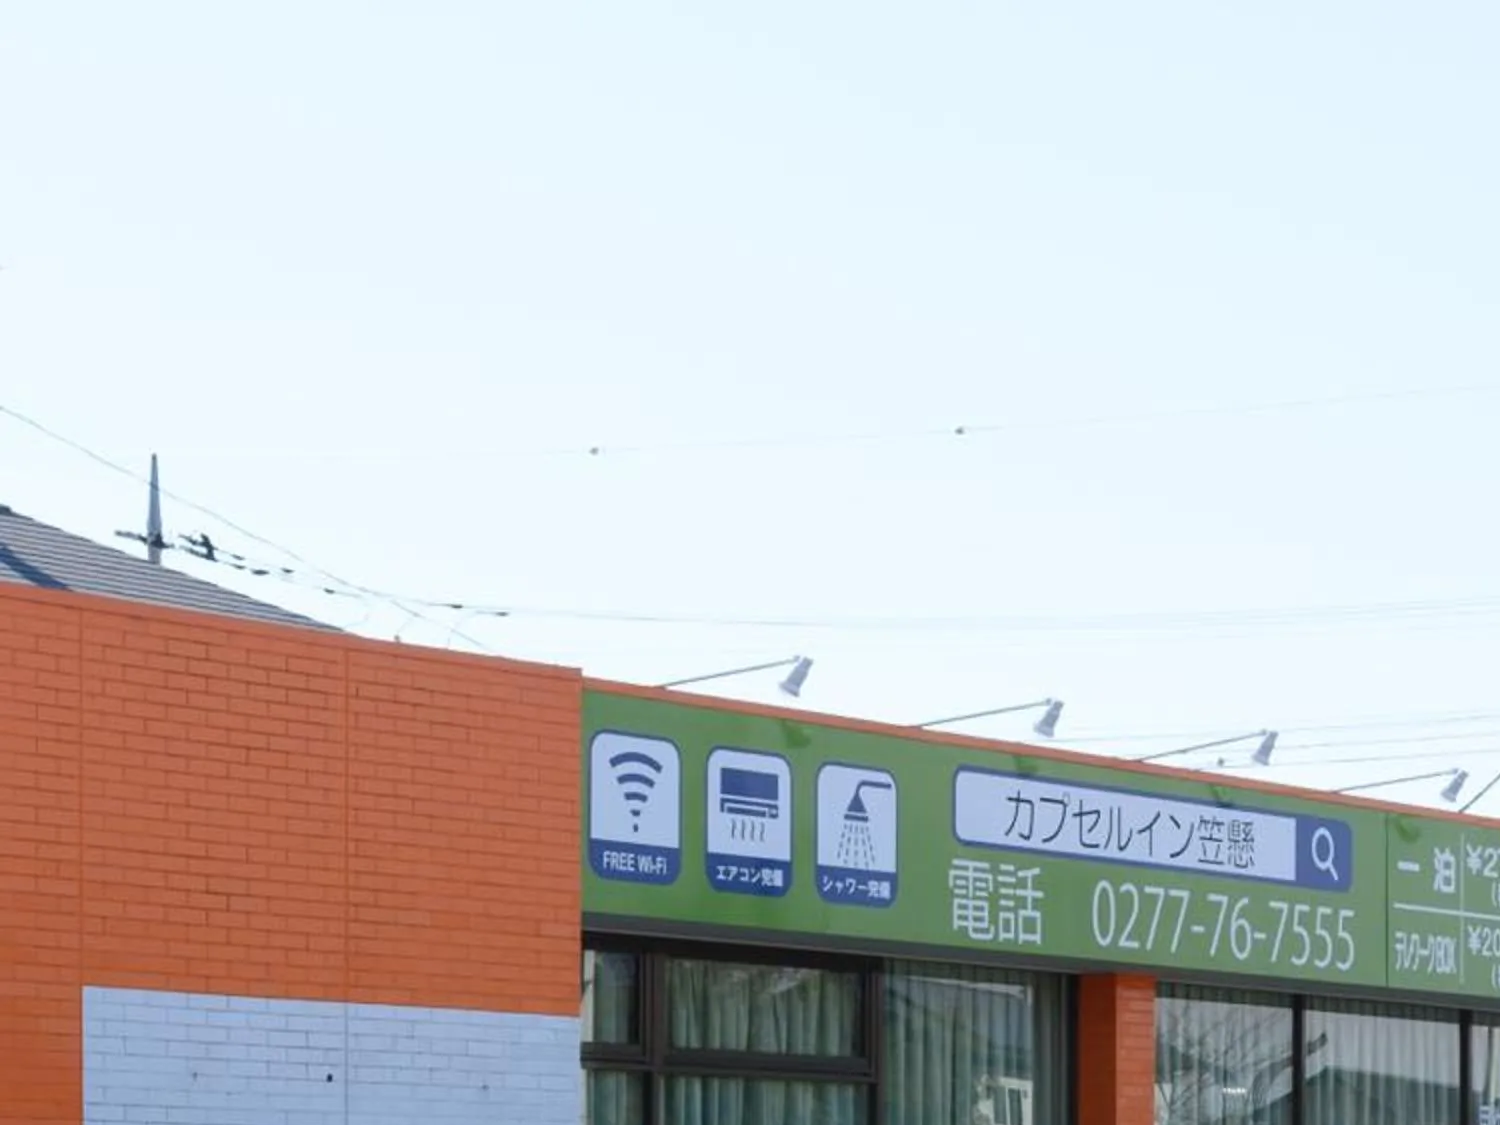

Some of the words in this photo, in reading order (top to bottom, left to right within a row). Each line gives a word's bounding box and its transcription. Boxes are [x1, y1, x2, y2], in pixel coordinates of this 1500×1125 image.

[1004, 790, 1256, 869] カプセルイン笠懸
[603, 850, 634, 872] FREE
[716, 865, 785, 888] エアコン完備
[822, 875, 893, 900] シャワー完備
[948, 858, 1045, 946] 電話
[1092, 879, 1356, 972] 0277-76-7555
